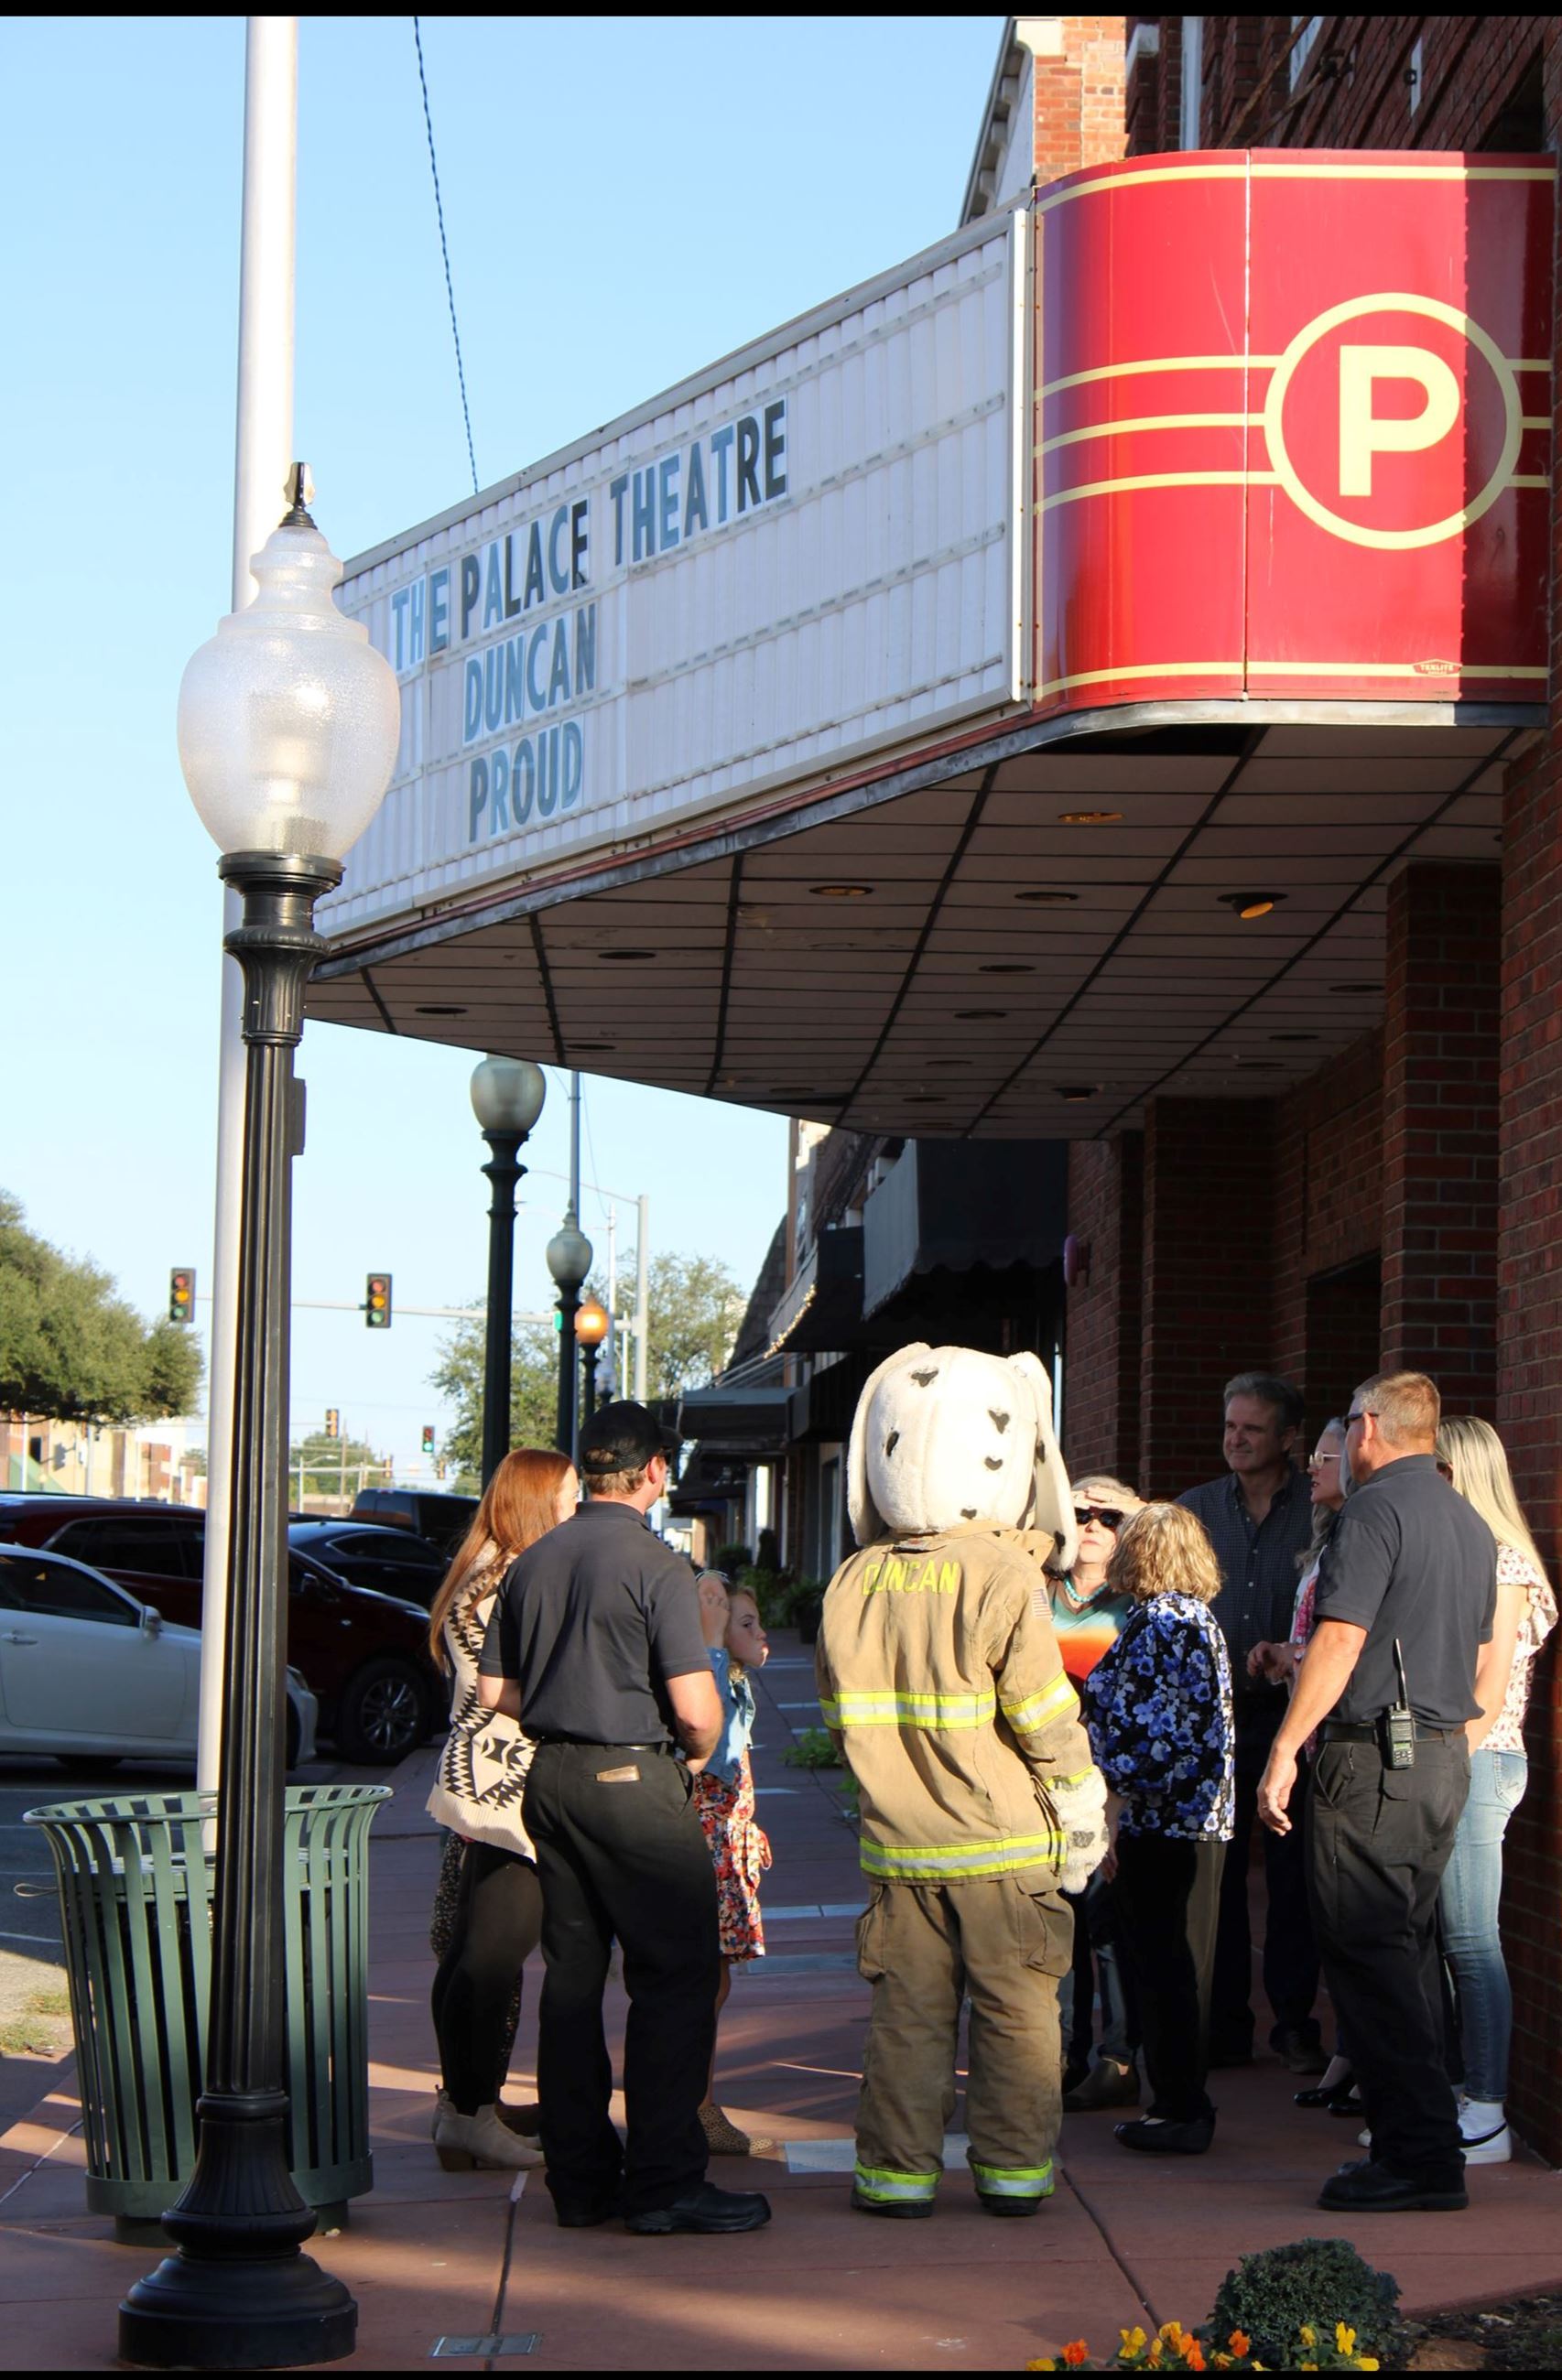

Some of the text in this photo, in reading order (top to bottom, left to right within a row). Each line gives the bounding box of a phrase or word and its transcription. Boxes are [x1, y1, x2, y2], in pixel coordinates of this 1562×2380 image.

[1340, 345, 1460, 496] P
[391, 399, 787, 672] THE PALACE THEATRE
[464, 602, 596, 743] DUNCAN
[470, 721, 582, 842] PROUD
[862, 1559, 960, 1596] DUNCAN
